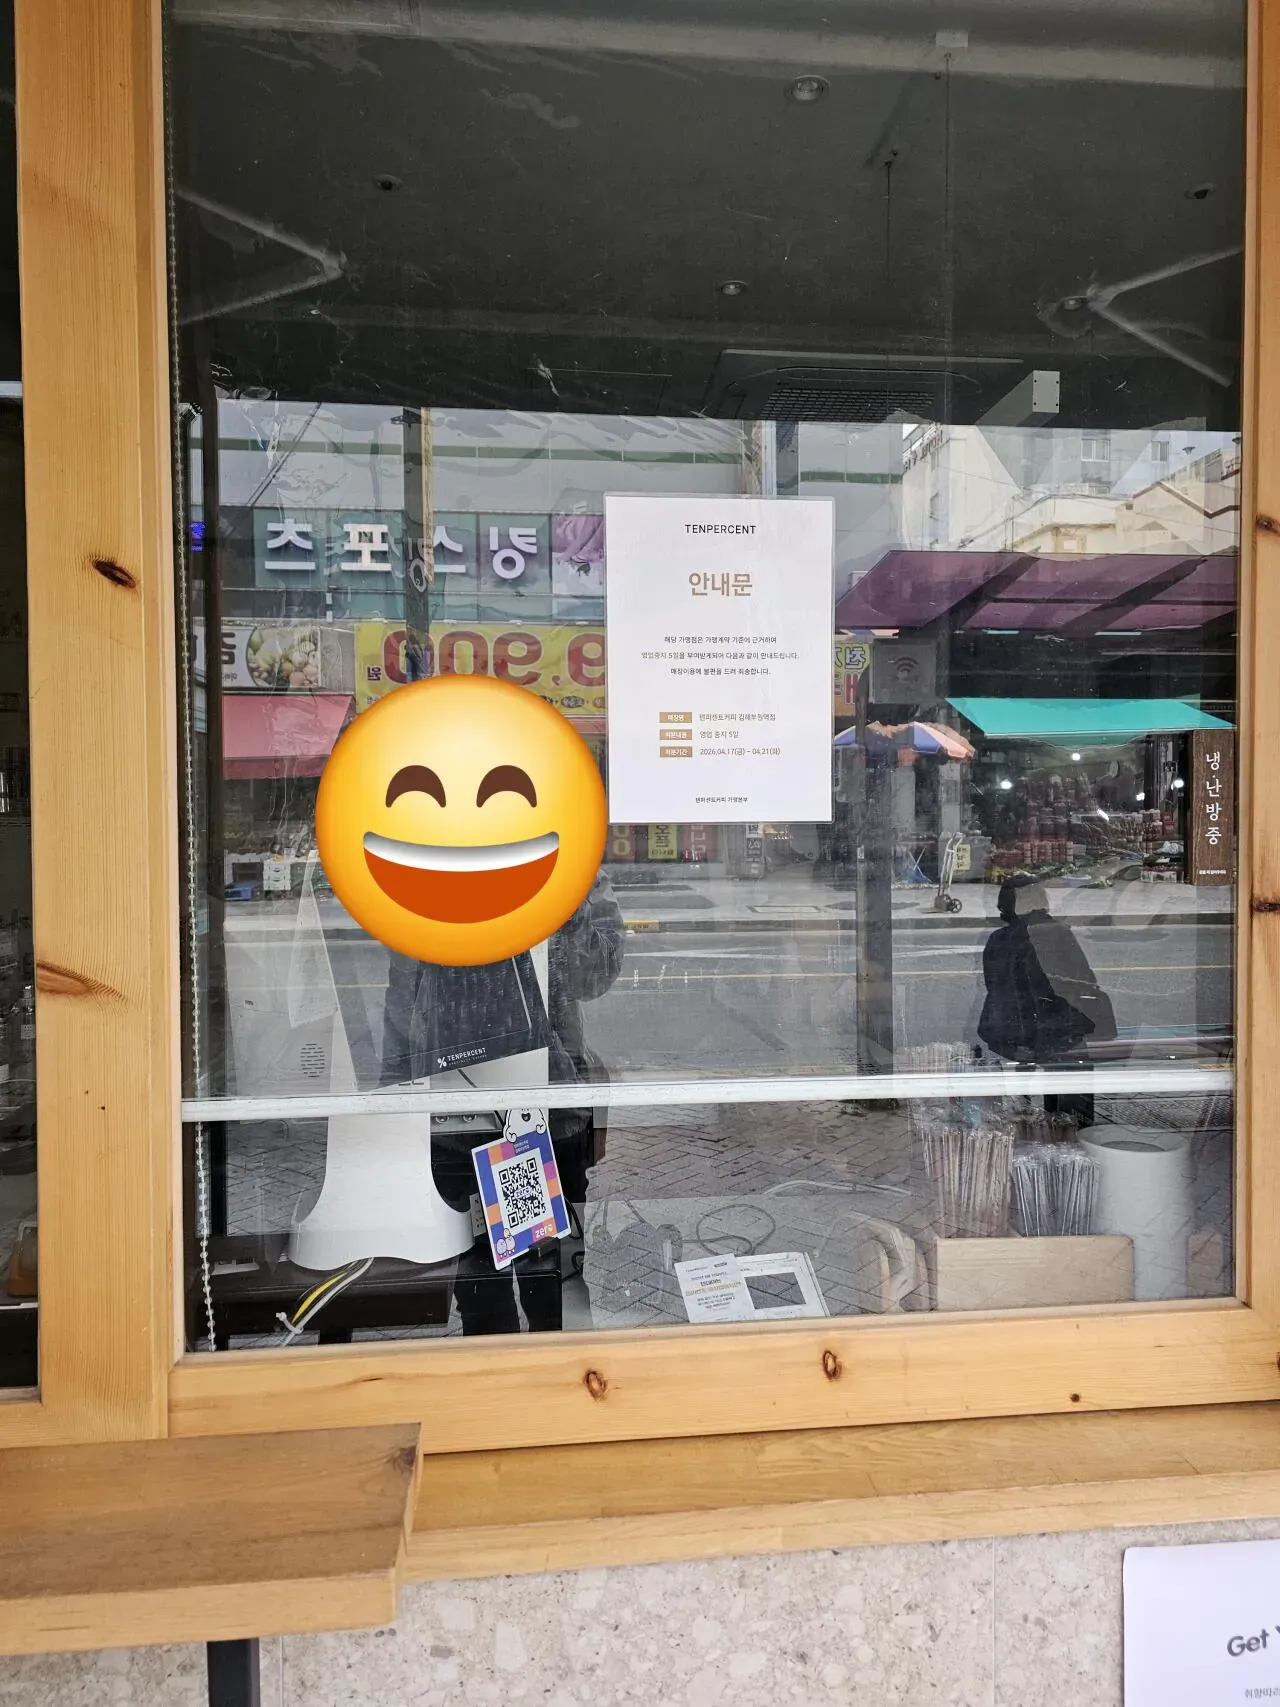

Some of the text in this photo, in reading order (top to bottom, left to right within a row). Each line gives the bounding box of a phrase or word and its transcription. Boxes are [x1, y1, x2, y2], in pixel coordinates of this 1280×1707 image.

[684, 524, 757, 535] TENPERCENT
[688, 572, 753, 597] 안내문
[664, 636, 677, 644] 해당
[752, 636, 777, 644] 근거하여
[641, 651, 667, 660] 영업중지
[668, 651, 685, 660] 5일을
[725, 651, 745, 660] 다음과
[746, 651, 759, 660] 같이
[703, 667, 722, 676] 불편을
[723, 667, 736, 676] 드려
[700, 730, 713, 739] 영업
[714, 730, 727, 739] 중지
[728, 730, 739, 739] 5일
[447, 1047, 486, 1062] TENPERCENT
[535, 1223, 553, 1238] zero
[1227, 1629, 1269, 1657] Get
